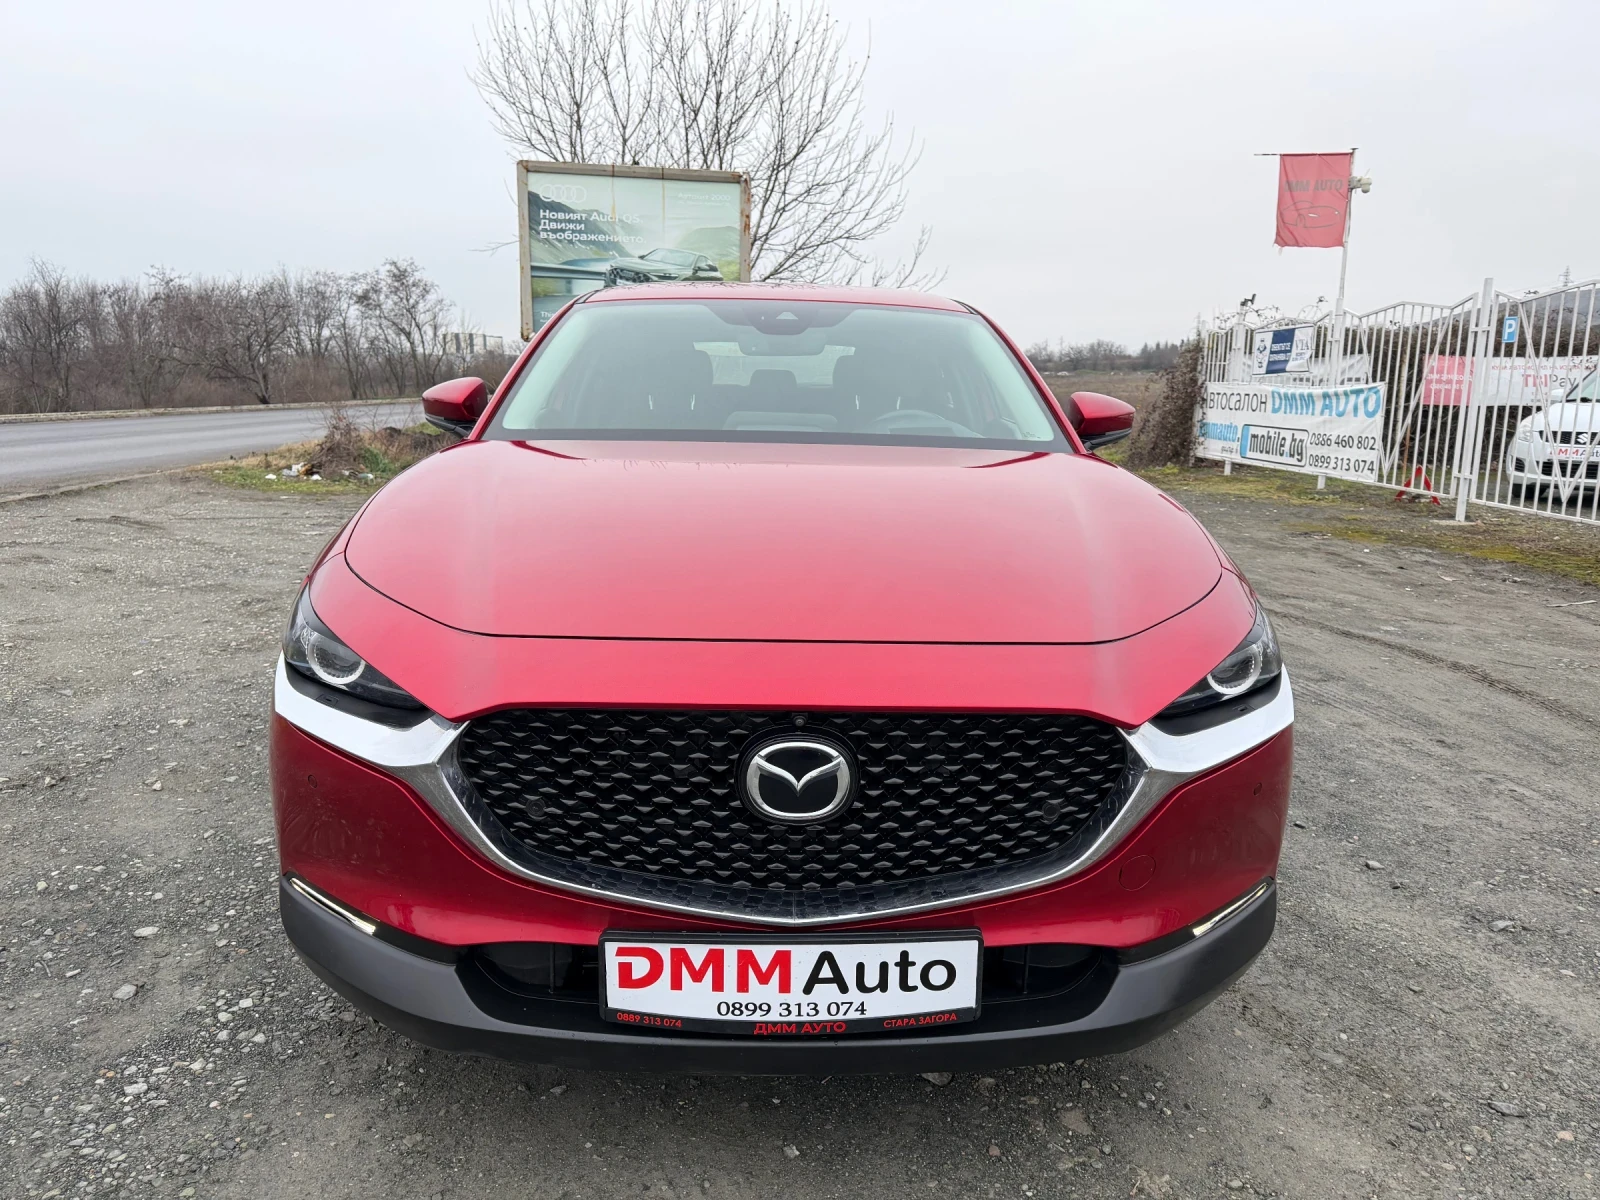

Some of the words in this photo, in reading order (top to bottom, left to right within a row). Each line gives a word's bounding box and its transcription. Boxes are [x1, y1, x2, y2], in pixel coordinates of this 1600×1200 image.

[1313, 179, 1344, 192] AUTO
[540, 209, 587, 221] Новият
[590, 211, 618, 223] Audi
[539, 219, 585, 231] Движи
[540, 231, 647, 244] въображението.
[1504, 319, 1515, 339] P
[1271, 387, 1316, 416] DMM
[1320, 386, 1381, 418] AUTO
[1248, 429, 1305, 462] mobile.bg
[1309, 432, 1333, 447] 0886
[1334, 434, 1355, 449] 460
[1356, 435, 1377, 451] 802
[1308, 453, 1332, 469] 0899
[1332, 456, 1352, 472] 313
[1353, 458, 1376, 474] 074
[717, 1001, 772, 1017] 0899
[778, 1002, 820, 1017] 313
[826, 1001, 868, 1016] 074
[616, 1012, 640, 1023] 0889
[643, 1016, 662, 1026] 313
[663, 1018, 682, 1028] 074
[883, 1018, 916, 1029] СТАРА
[918, 1012, 957, 1025] ЗАГОРА
[753, 1022, 797, 1036] ДММ
[801, 1021, 847, 1034] АУТО
